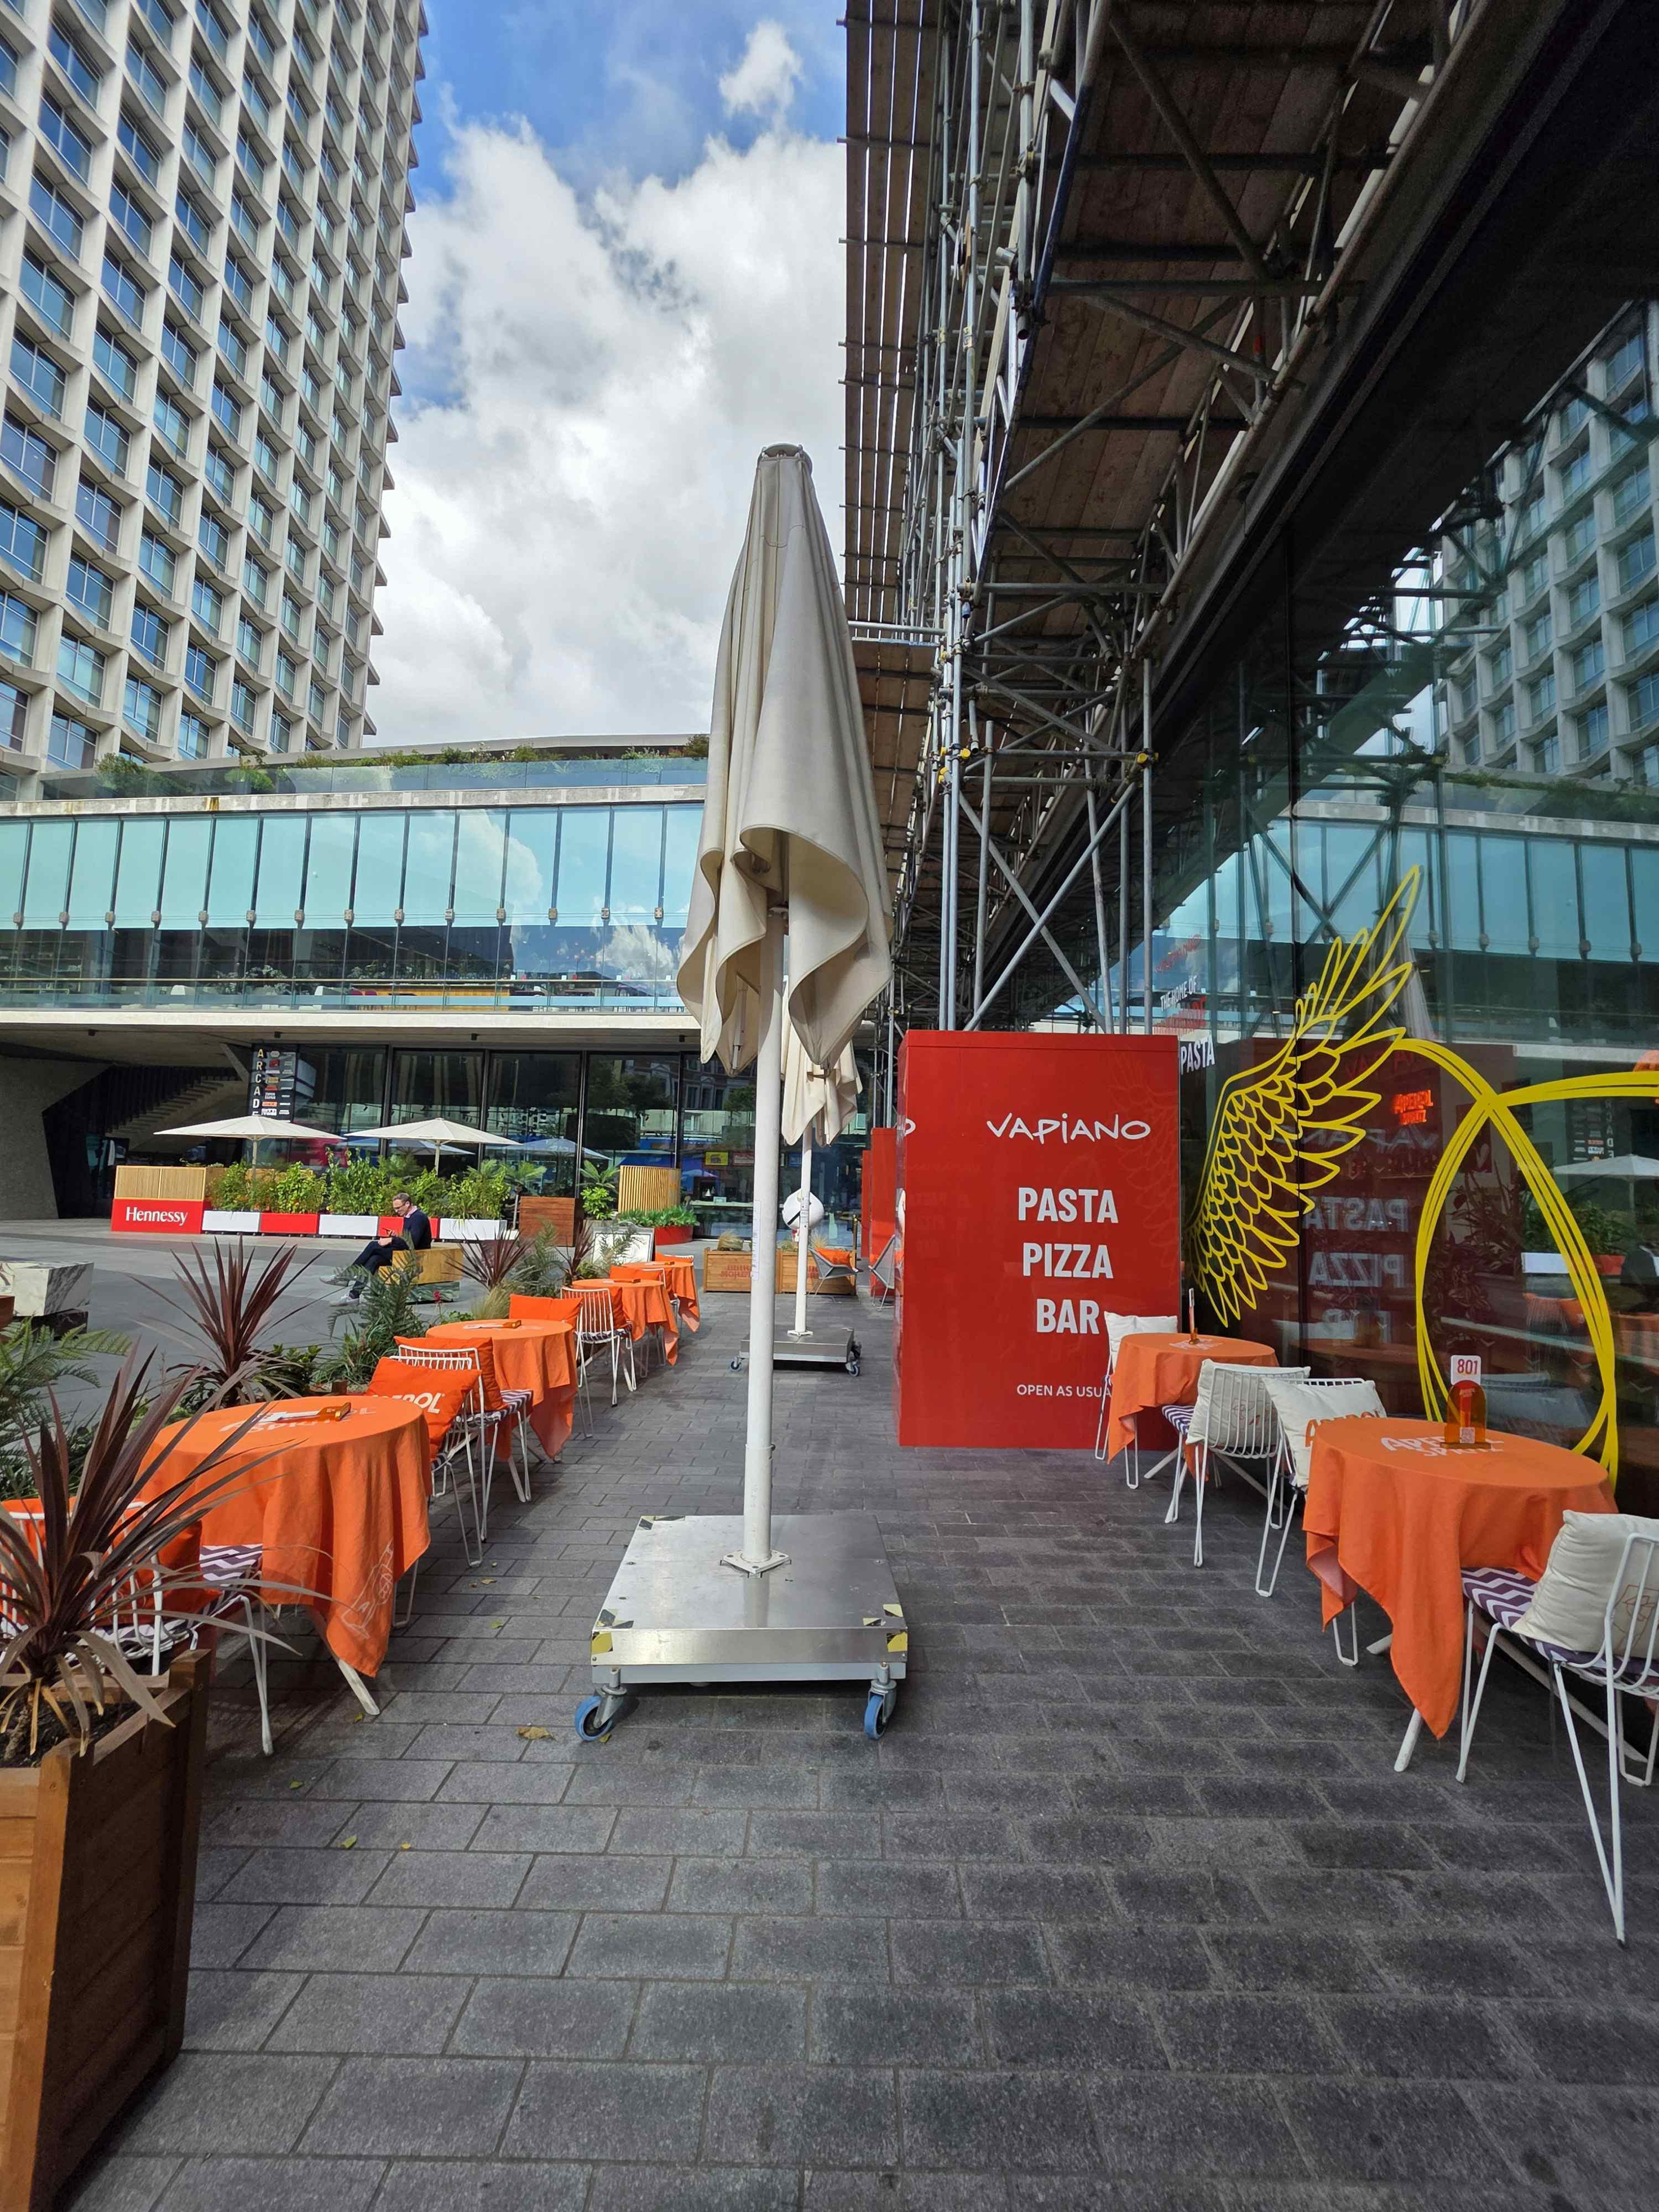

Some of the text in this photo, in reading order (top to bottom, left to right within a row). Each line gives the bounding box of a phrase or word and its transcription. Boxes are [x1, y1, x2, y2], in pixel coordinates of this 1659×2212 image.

[1181, 1035, 1215, 1075] PASTA
[987, 1113, 1151, 1144] VAPIANO
[125, 1206, 188, 1226] Hennessy
[1018, 1187, 1118, 1223] PASTA
[1022, 1243, 1114, 1279] PIZZA
[1036, 1298, 1100, 1334] BAR
[1457, 1359, 1478, 1375] 801
[1017, 1384, 1112, 1397] OPEN AS USUA
